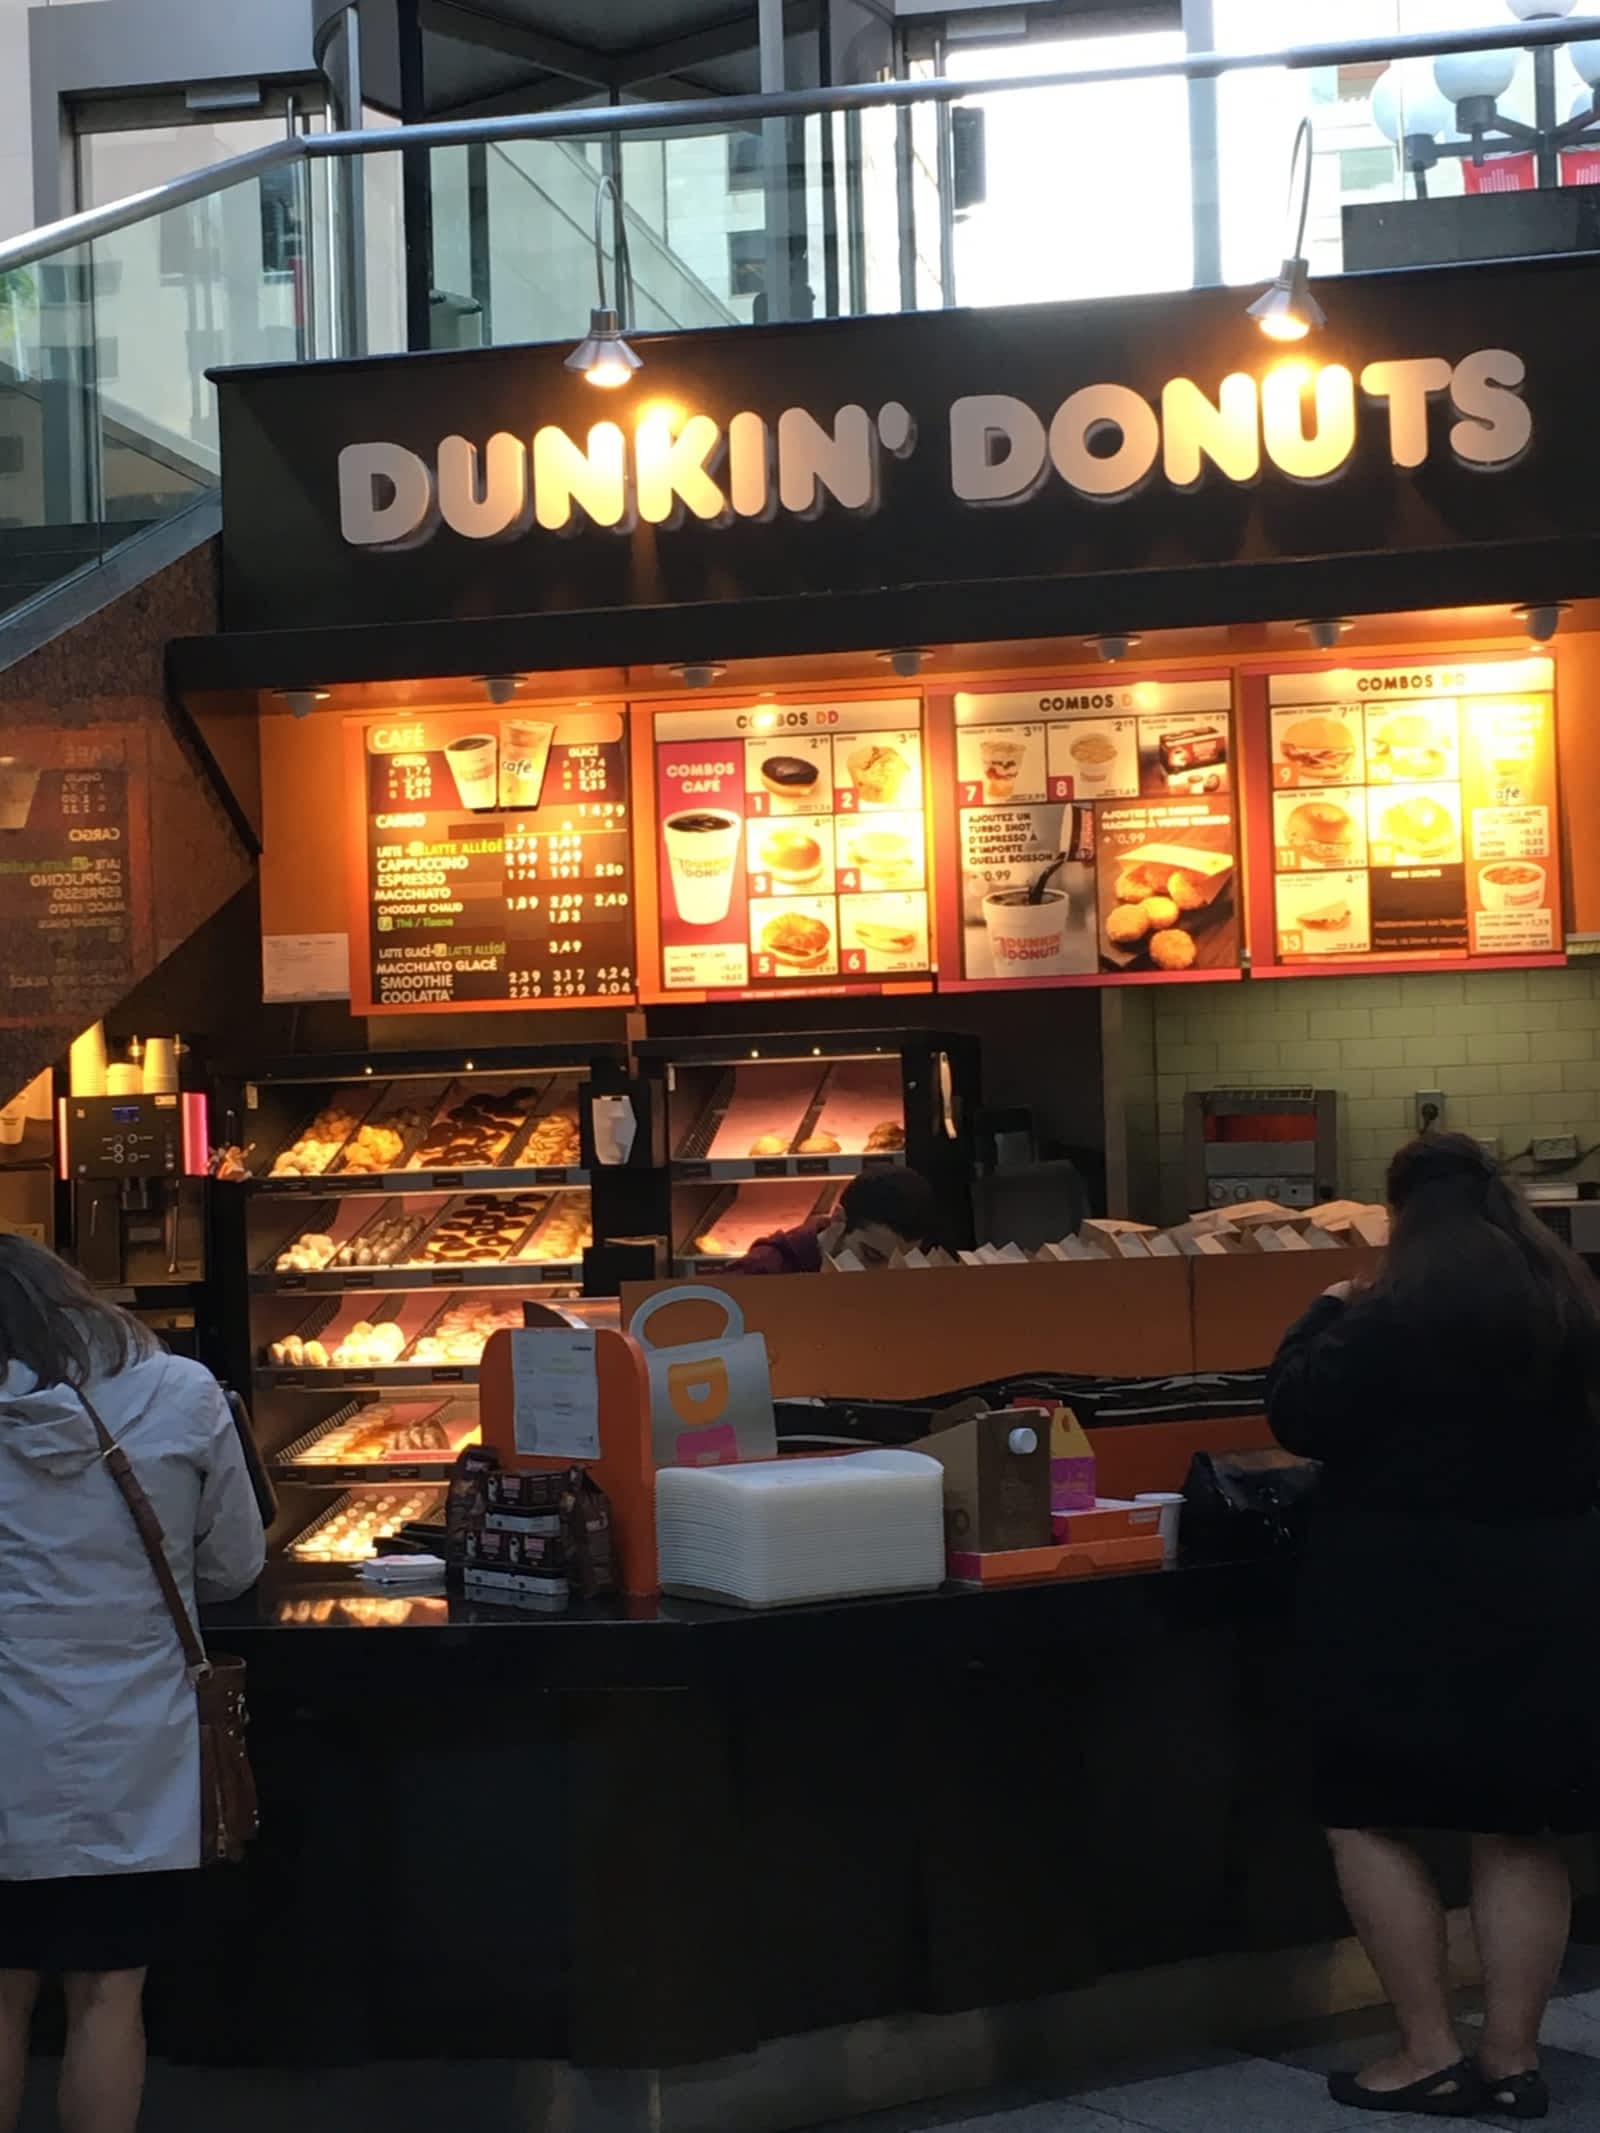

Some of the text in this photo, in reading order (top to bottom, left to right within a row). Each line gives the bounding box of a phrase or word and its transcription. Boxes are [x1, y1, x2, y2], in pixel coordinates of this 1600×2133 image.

[338, 349, 1533, 545] DUNKIN' DONUTS
[1356, 674, 1433, 692] COMBOS
[1038, 694, 1115, 712] COMBOS
[815, 710, 840, 725] DD
[374, 722, 424, 750] CAFÉ
[666, 761, 735, 778] COMBOS
[1279, 767, 1292, 783] 9
[681, 775, 721, 794] CAFÉ
[1055, 780, 1068, 797] 8
[840, 792, 853, 809] 2
[965, 785, 977, 802] 7
[752, 795, 764, 812] 1
[968, 812, 1032, 823] AJOUTEZ UN
[968, 823, 1002, 833] TURBO
[377, 845, 403, 858] LATTE
[424, 844, 457, 856] LATTE
[968, 853, 1053, 865] QUELLE BOISSON
[377, 855, 469, 872] CAPPUCCINO
[378, 871, 447, 887] ESPRESSO
[753, 875, 767, 893] 3
[842, 871, 857, 888] 4
[375, 886, 452, 901] MACCHIATO
[379, 947, 402, 959] LATTE
[447, 945, 473, 956] LATTE
[376, 957, 498, 975] MACCHIATO GLACÉ
[756, 955, 770, 974] 5
[847, 952, 861, 971] 6
[380, 974, 454, 989] SMOOTHIE
